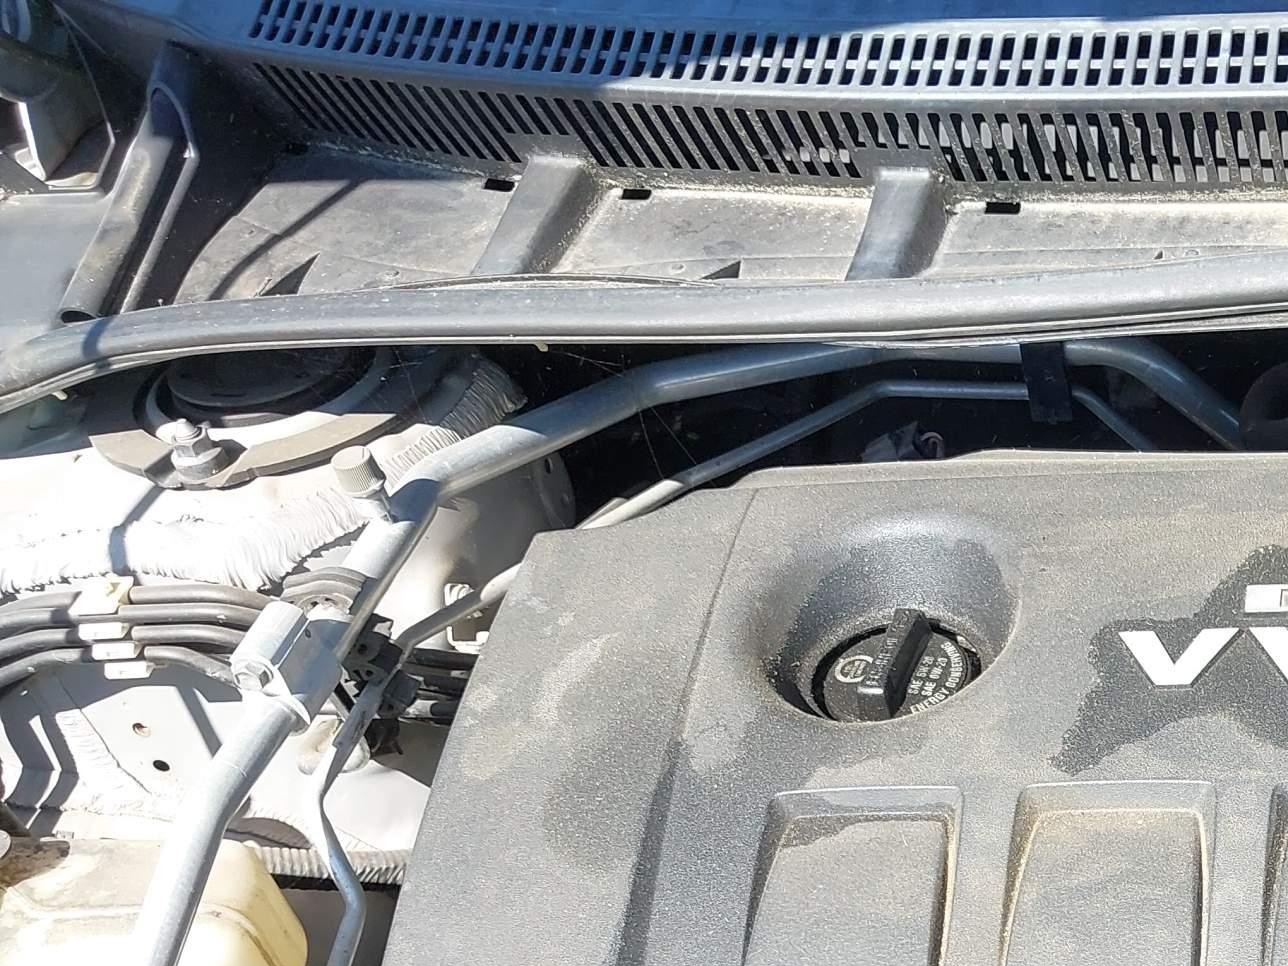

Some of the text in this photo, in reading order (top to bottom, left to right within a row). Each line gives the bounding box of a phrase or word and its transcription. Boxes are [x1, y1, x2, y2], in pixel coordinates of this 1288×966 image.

[909, 641, 963, 714] ENERGY CONSERVING
[921, 681, 937, 696] SAE
